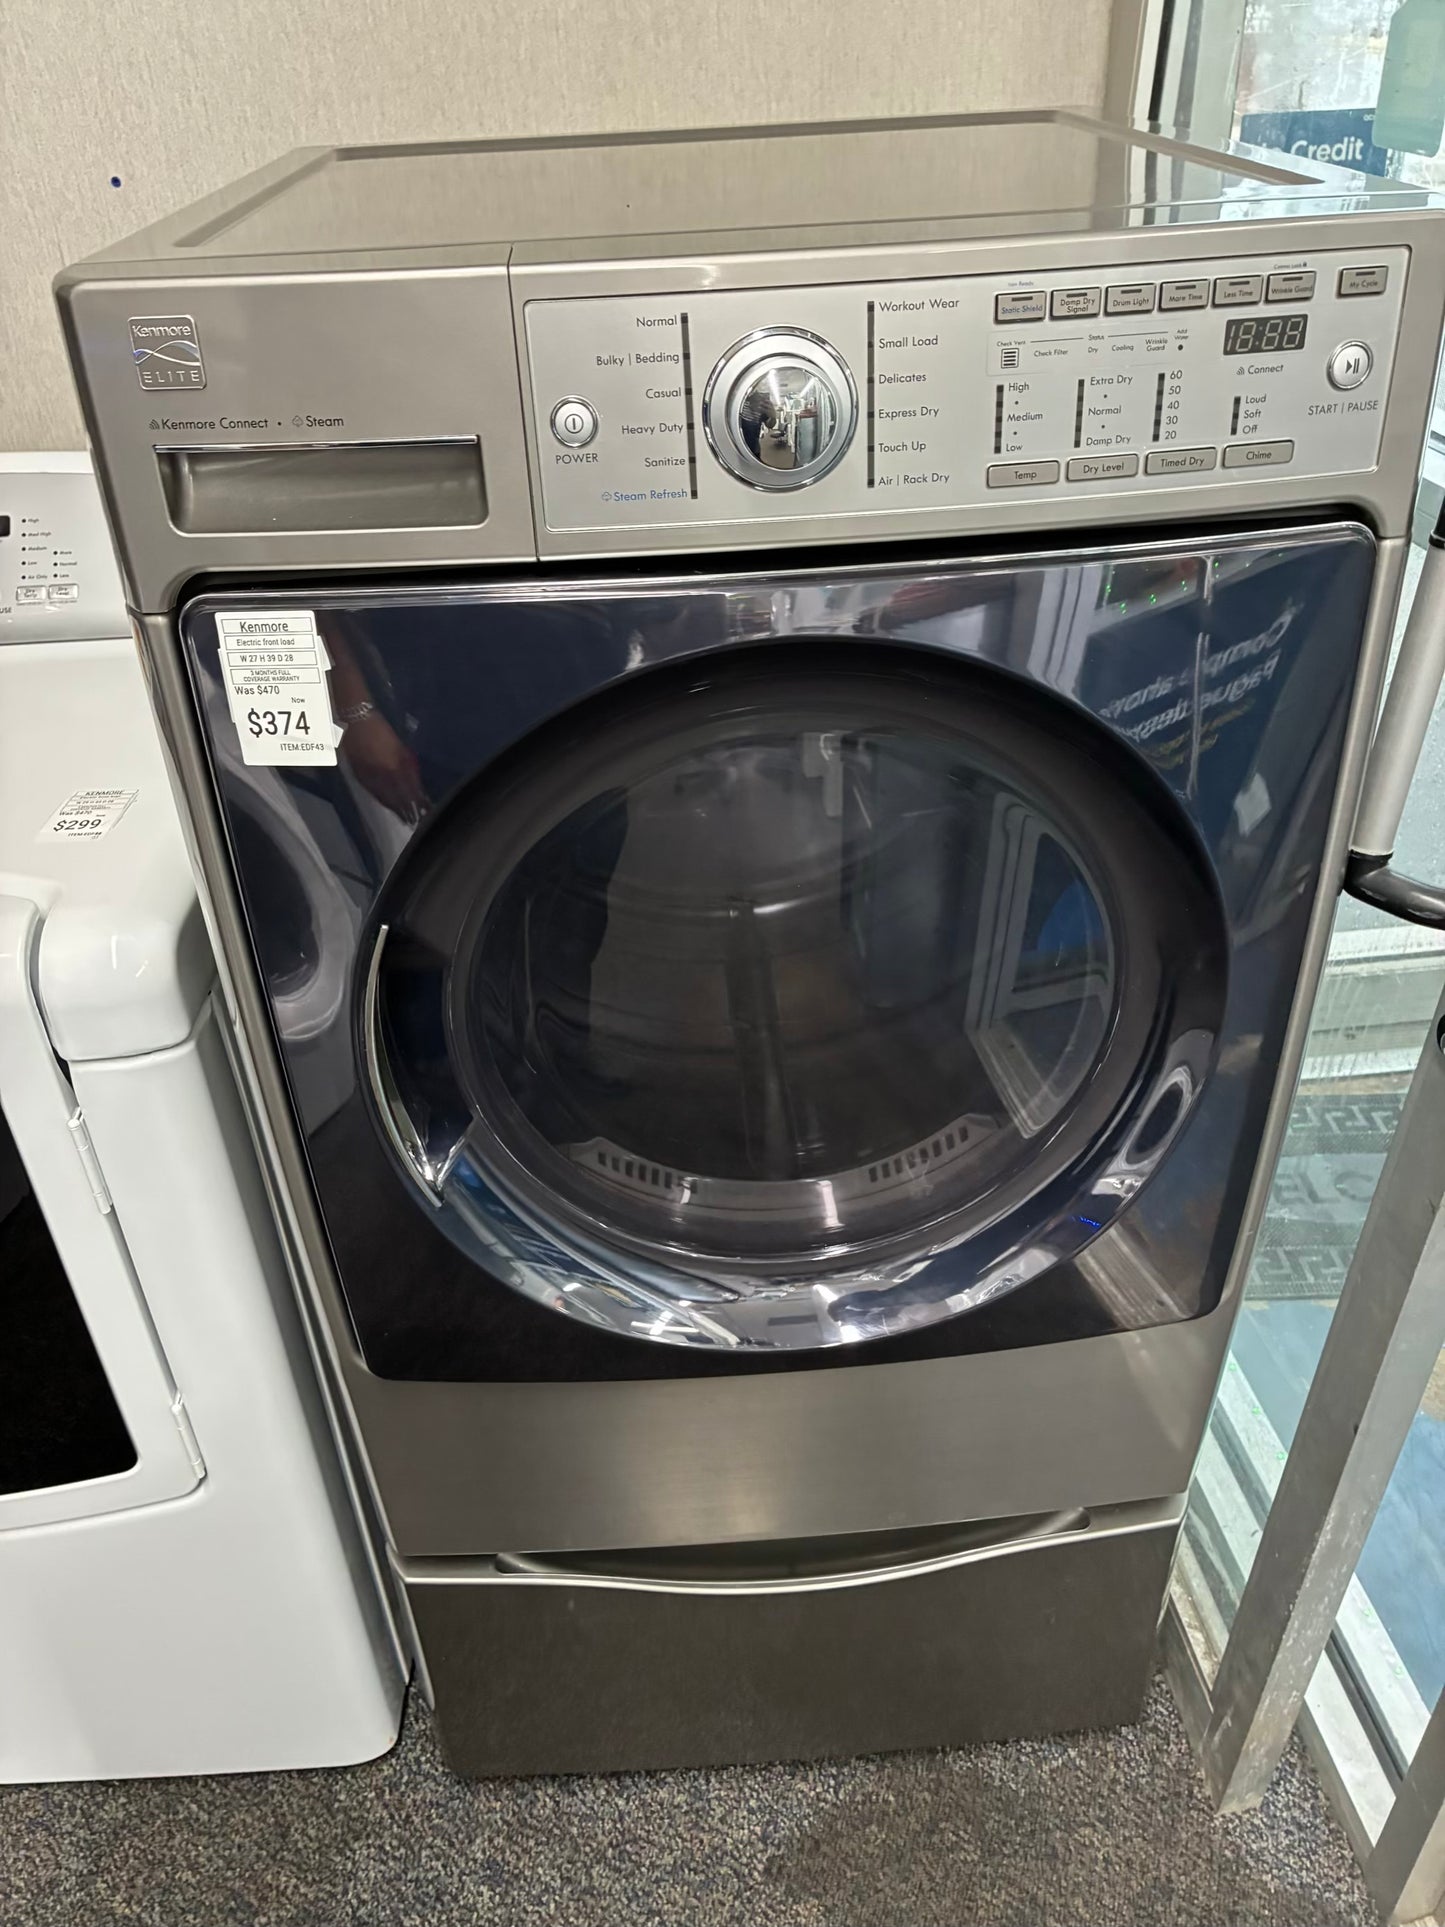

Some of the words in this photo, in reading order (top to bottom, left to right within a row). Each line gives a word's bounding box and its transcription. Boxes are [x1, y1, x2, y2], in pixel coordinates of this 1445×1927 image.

[1290, 136, 1364, 162] Credit
[1294, 284, 1313, 294] Guard
[1349, 280, 1360, 290] My
[1361, 279, 1378, 289] Cycle
[1168, 294, 1187, 303] More
[1188, 293, 1203, 301] Time
[1224, 291, 1237, 299] Less
[1238, 289, 1253, 297] Time
[879, 301, 925, 312] Workout
[929, 298, 960, 309] Wear
[1060, 299, 1081, 307] Damp
[1083, 297, 1096, 307] Dry
[1112, 298, 1131, 308] Drum
[1132, 297, 1150, 308] Light
[1001, 305, 1020, 315] Static
[1022, 303, 1043, 314] Shield
[1066, 306, 1089, 315] Signal
[636, 315, 677, 327] Normal
[132, 324, 191, 337] Kenmore
[879, 336, 908, 349] Small
[912, 335, 938, 347] Load
[1145, 338, 1168, 346] Wrinkle
[1034, 349, 1052, 358] Check
[1054, 348, 1069, 357] Filter
[1088, 346, 1098, 355] Dry
[1112, 344, 1134, 353] Cooling
[596, 355, 624, 367] Bulky
[636, 353, 680, 365] Bedding
[1169, 370, 1183, 381] 60
[1247, 364, 1284, 376] Connect
[142, 370, 200, 383] ELITE
[879, 373, 927, 384] Delicates
[1090, 376, 1114, 387] Extra
[1116, 375, 1134, 387] Dry
[646, 387, 682, 399] Casual
[1008, 382, 1029, 394] High
[1168, 385, 1182, 396] 50
[1245, 393, 1267, 405] Loud
[1088, 406, 1122, 416] Normal
[1166, 400, 1180, 411] 40
[1308, 403, 1338, 416] START
[1347, 400, 1379, 413] PAUSE
[879, 408, 917, 421] Express
[920, 406, 940, 418] Dry
[1007, 412, 1043, 423] Medium
[1243, 409, 1262, 420] Soft
[162, 418, 216, 430] Kenmore
[219, 417, 269, 429] Connect
[305, 415, 344, 427] Steam
[1165, 415, 1179, 426] 30
[622, 425, 655, 436] Heavy
[659, 423, 684, 434] Duty
[1242, 424, 1259, 435] Off
[1164, 430, 1177, 441] 20
[878, 442, 908, 453] Touch
[911, 441, 927, 453] Up
[1086, 437, 1112, 448] Damp
[1115, 435, 1131, 447] Dry
[1005, 443, 1023, 453] Low
[555, 453, 599, 464] POWER
[1246, 450, 1272, 461] Chime
[644, 457, 686, 468] Sanitize
[1160, 457, 1187, 468] Timed
[1189, 455, 1205, 468] Dry
[1083, 465, 1099, 476] Dry
[1102, 462, 1125, 473] Level
[878, 476, 893, 486] Air
[903, 474, 928, 485] Rack
[931, 472, 950, 484] Dry
[1014, 470, 1038, 481] Temp
[614, 491, 647, 502] Steam
[650, 489, 688, 500] Refresh
[239, 621, 289, 633] Kenmore
[237, 638, 262, 646] Electric
[263, 637, 279, 645] front
[280, 637, 295, 645] load
[267, 654, 276, 662] 39
[285, 654, 294, 662] 28
[234, 686, 255, 695] Was
[257, 685, 280, 695] $470
[247, 708, 310, 738] $374
[53, 819, 102, 831] $299
